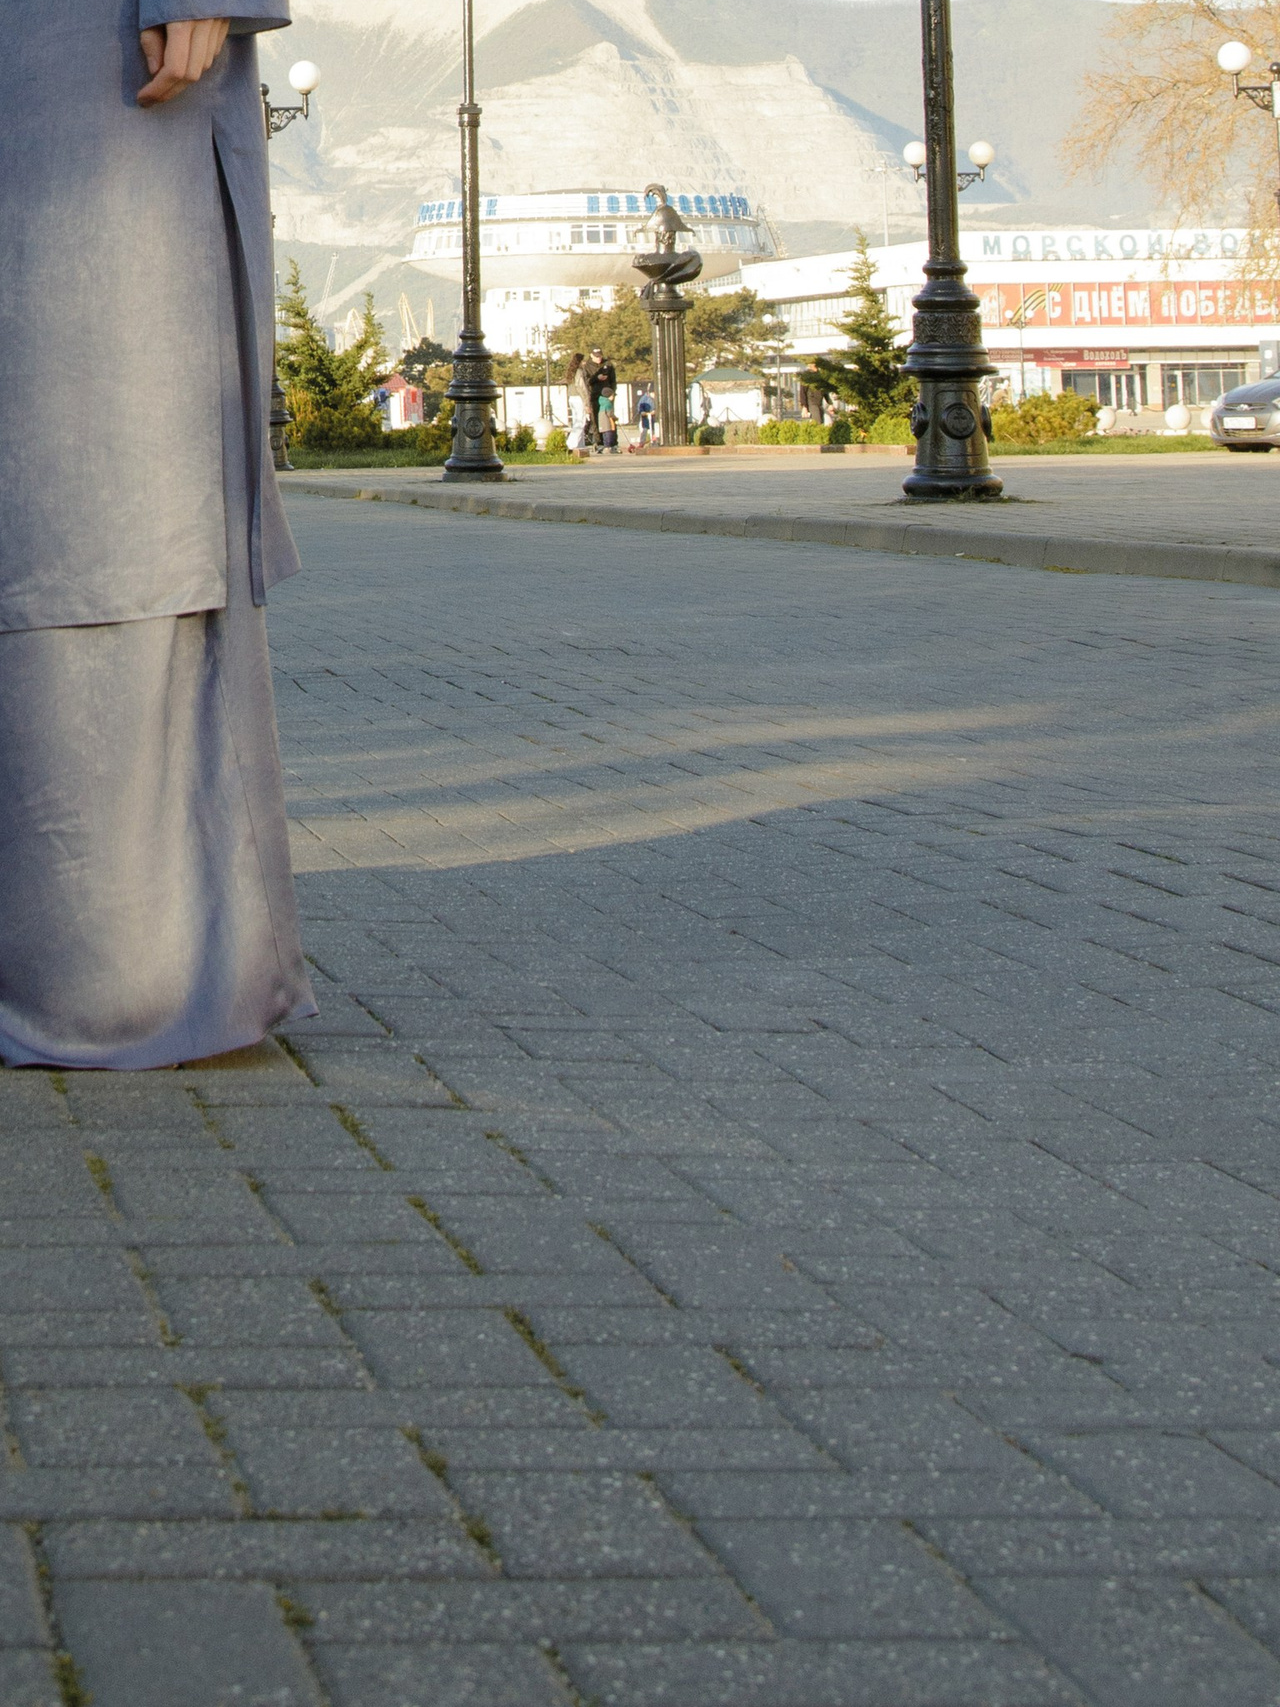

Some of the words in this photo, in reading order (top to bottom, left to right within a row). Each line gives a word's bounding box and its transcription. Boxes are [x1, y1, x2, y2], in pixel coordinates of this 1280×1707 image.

[982, 228, 1164, 256] МОРСКОЙ
[1048, 290, 1062, 319] С
[1073, 285, 1149, 322] ДНЁМ
